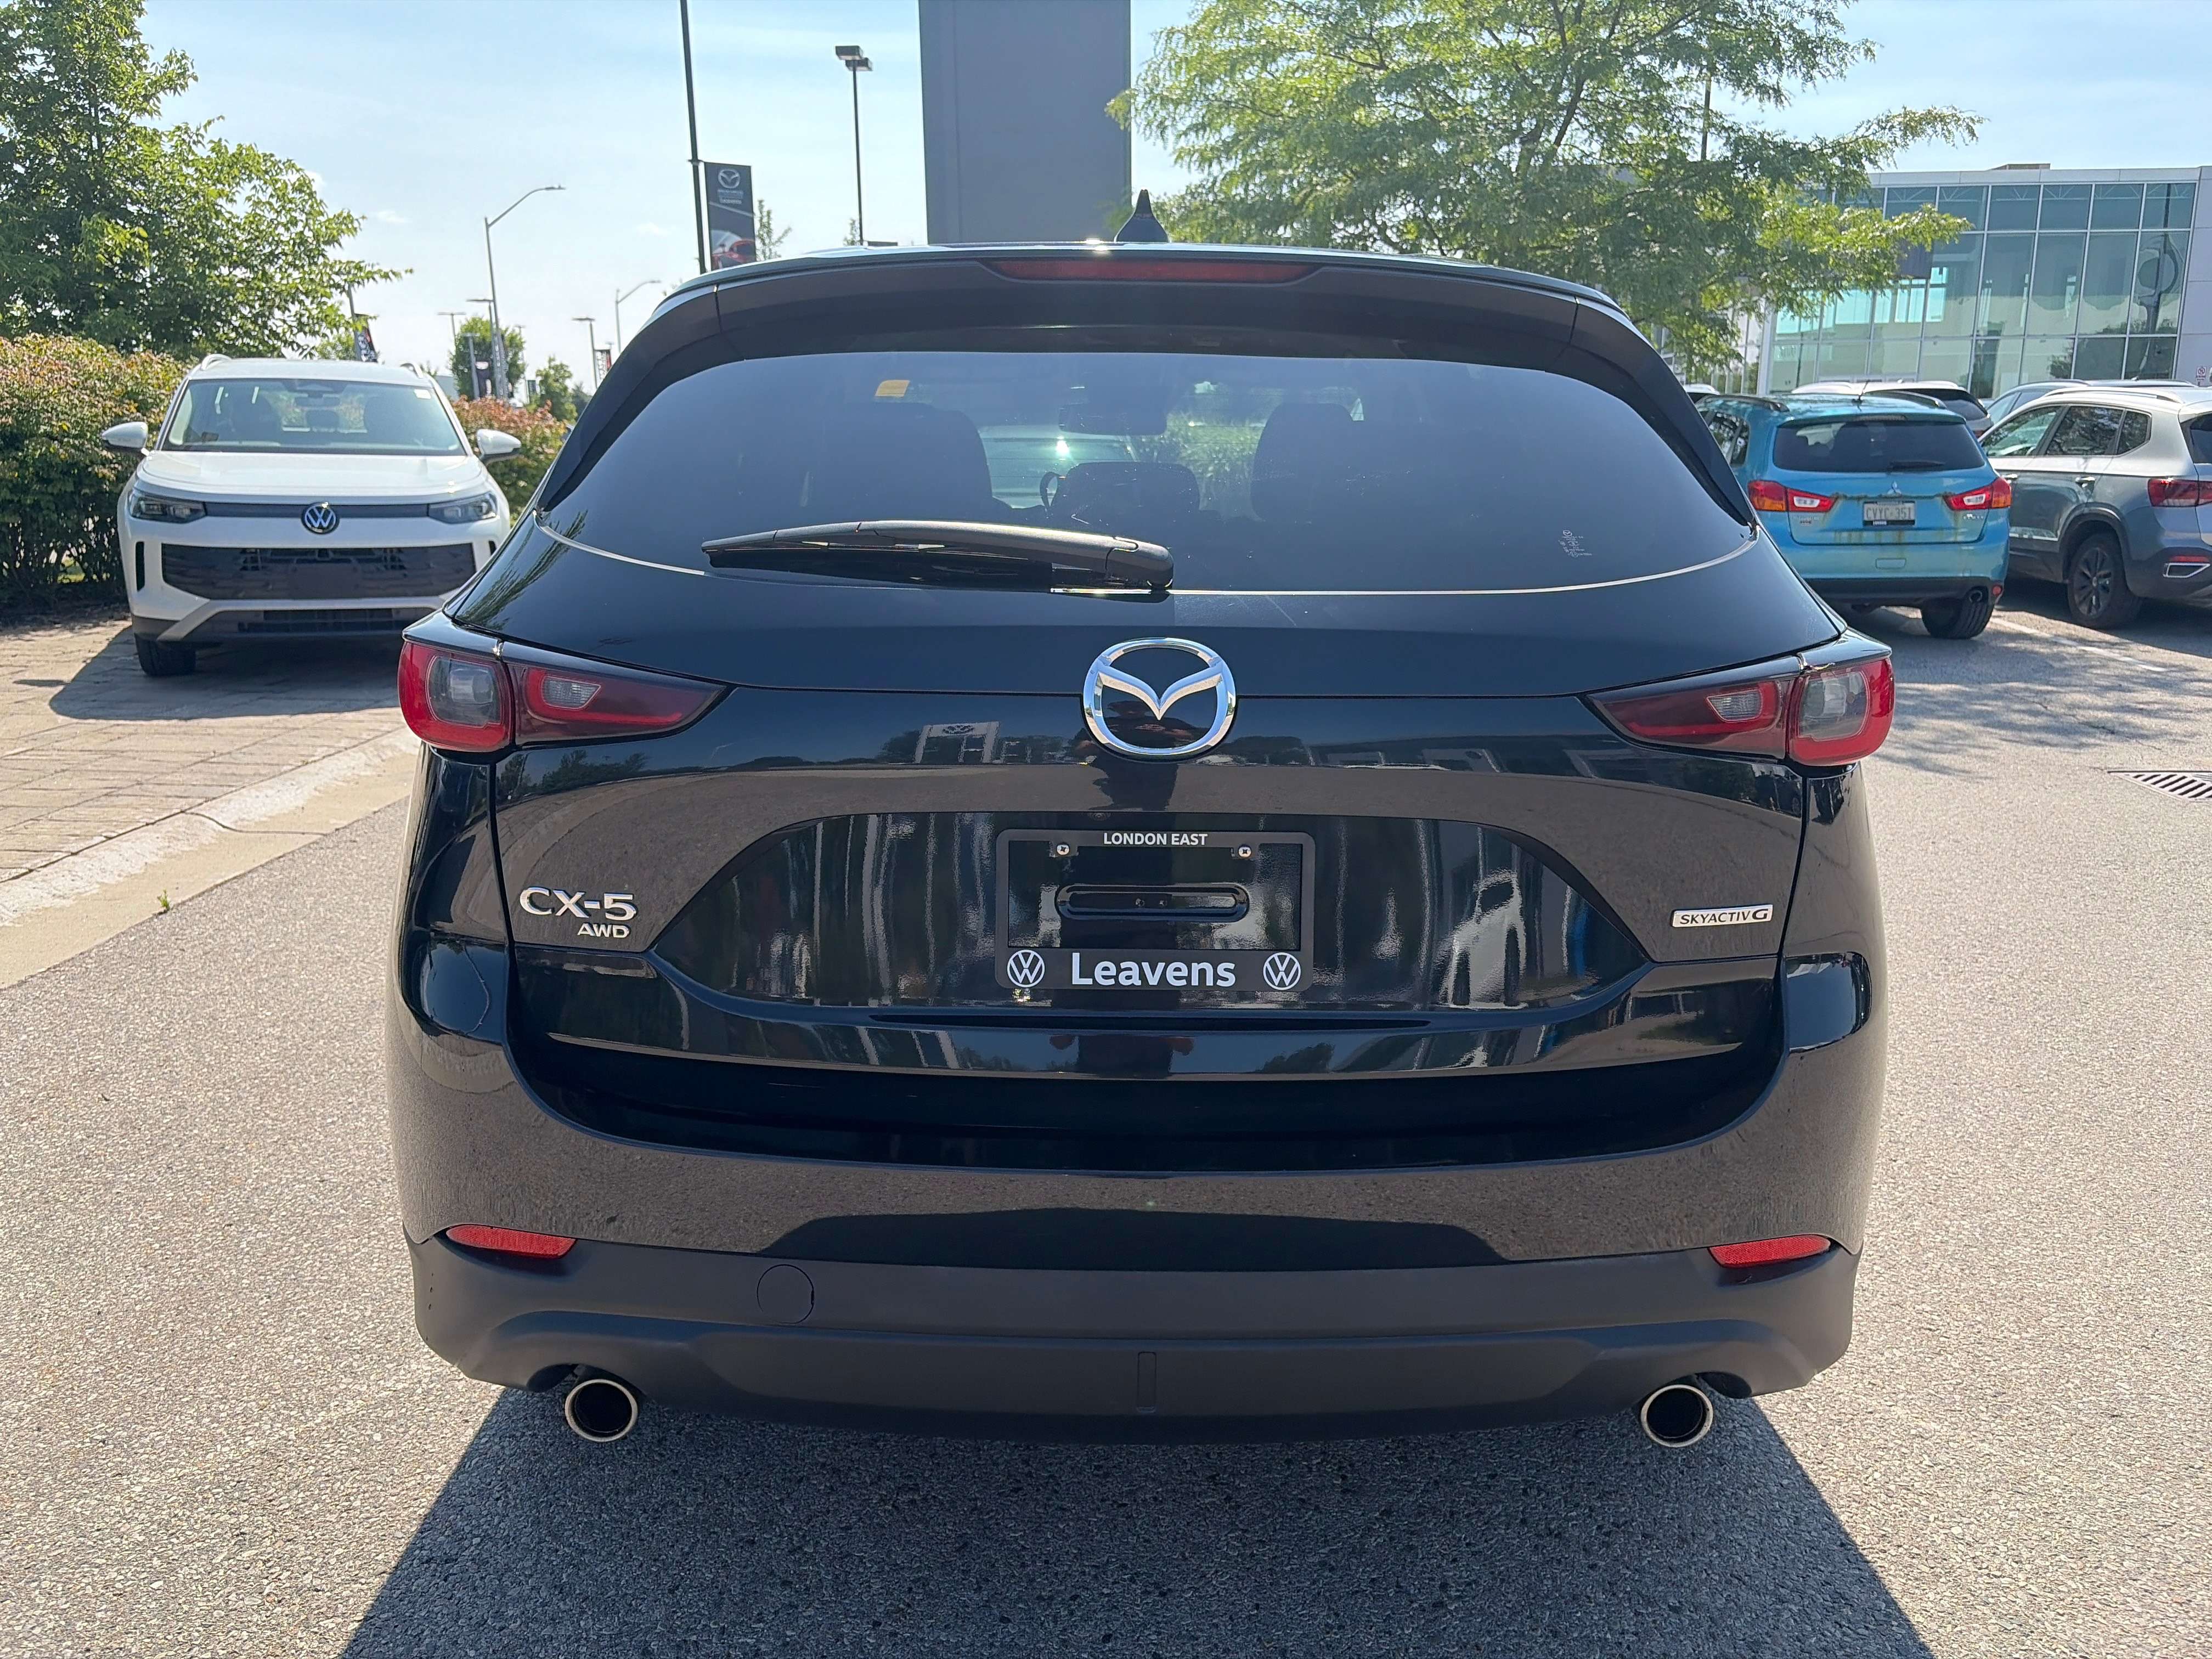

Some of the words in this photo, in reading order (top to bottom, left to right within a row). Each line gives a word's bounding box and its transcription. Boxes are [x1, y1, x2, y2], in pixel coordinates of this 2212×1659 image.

[1104, 832, 1167, 845] LONDON
[1171, 833, 1208, 845] EAST
[520, 887, 637, 921] CX-5
[577, 923, 630, 938] AWD
[1072, 952, 1236, 987] Leavens
